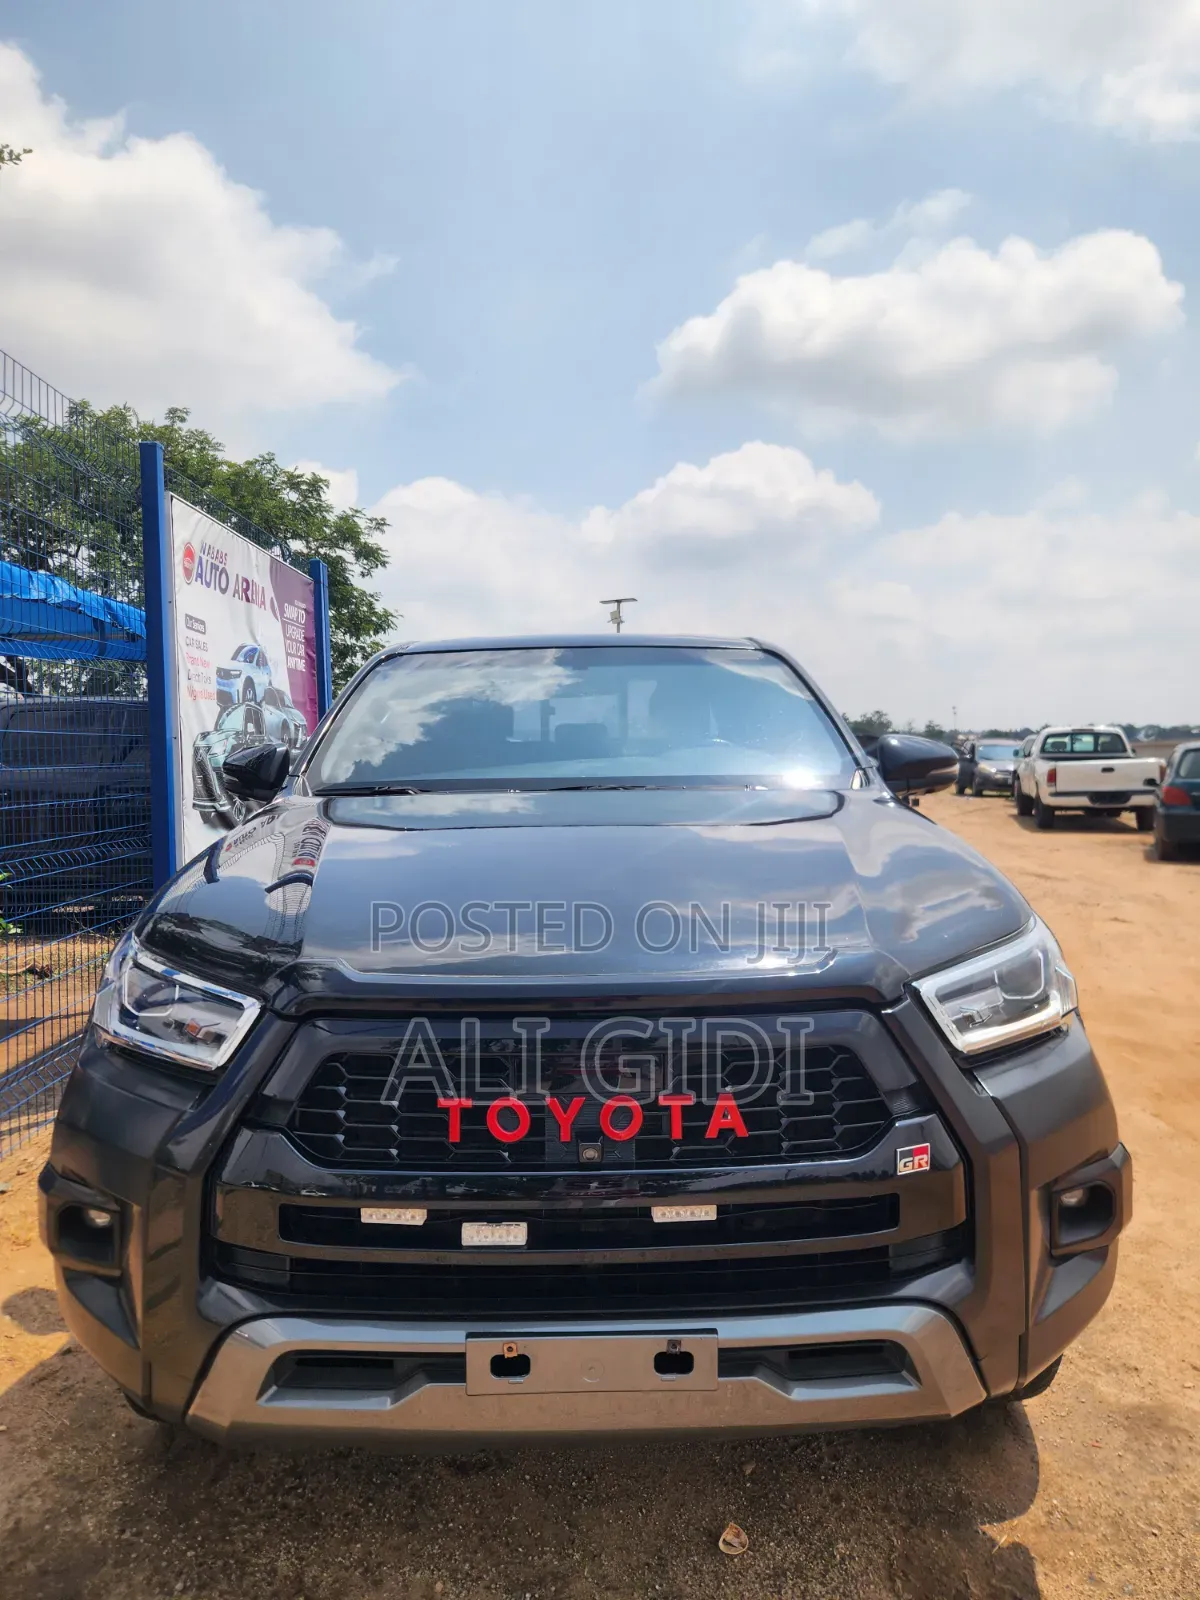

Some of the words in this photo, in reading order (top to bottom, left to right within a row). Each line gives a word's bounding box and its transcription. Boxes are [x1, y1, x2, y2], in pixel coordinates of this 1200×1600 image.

[195, 556, 229, 594] AUTO
[297, 609, 305, 624] TO
[286, 624, 305, 642] UPGRADE
[296, 643, 305, 657] CAR
[287, 656, 305, 672] ANYTIME
[437, 1094, 750, 1144] TOYOTA
[898, 1154, 929, 1174] GR
